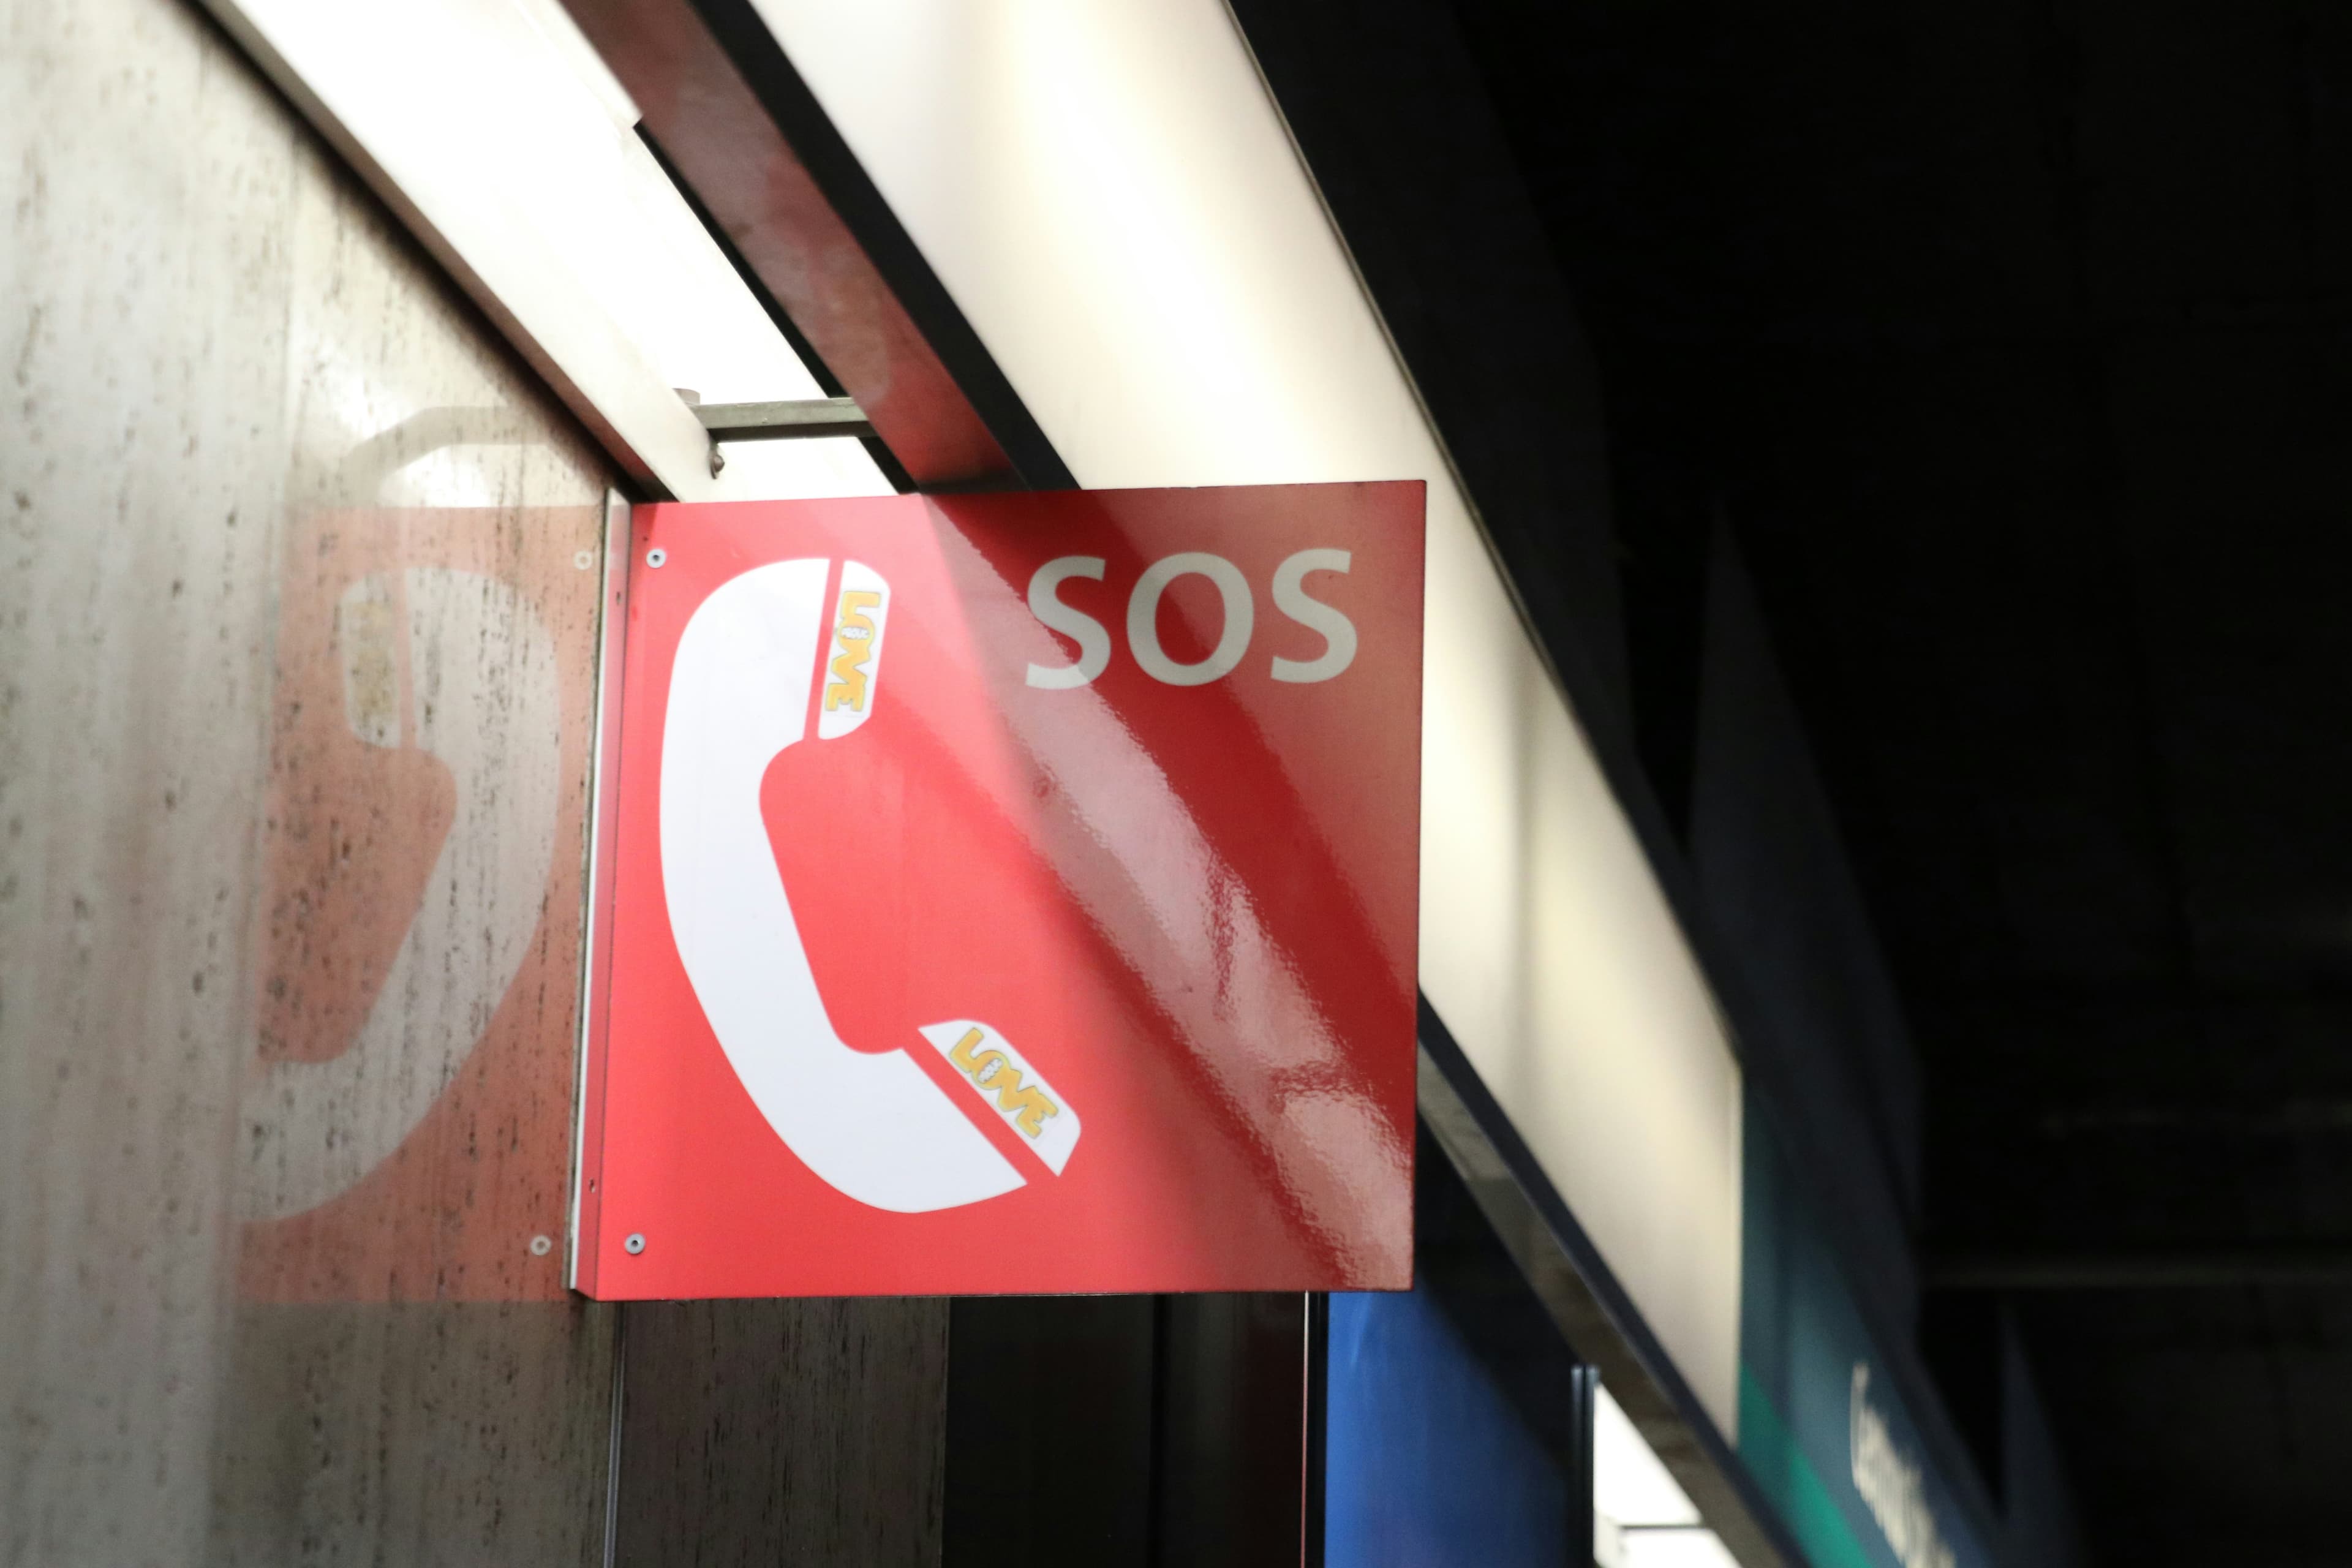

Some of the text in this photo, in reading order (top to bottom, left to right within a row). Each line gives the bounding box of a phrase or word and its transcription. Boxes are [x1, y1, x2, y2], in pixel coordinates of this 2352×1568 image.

[825, 590, 881, 712] LOVE
[1025, 548, 1358, 690] SOS
[949, 1027, 1059, 1139] LOVE
